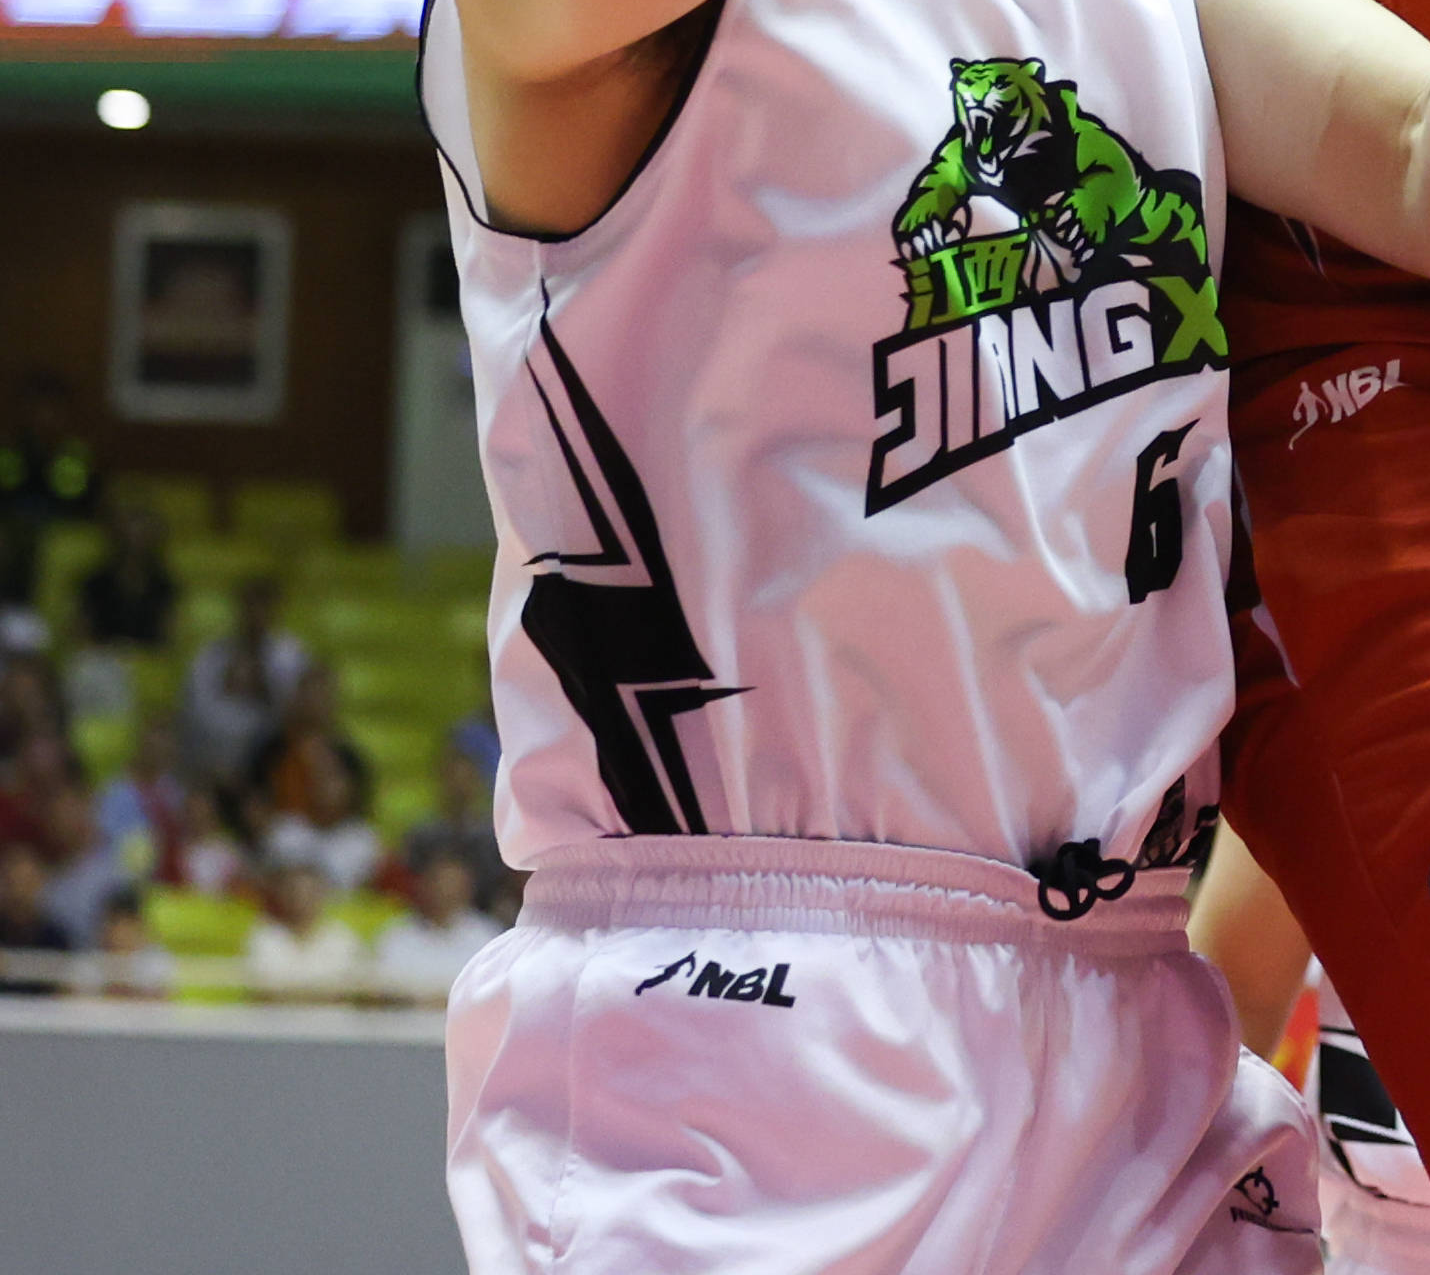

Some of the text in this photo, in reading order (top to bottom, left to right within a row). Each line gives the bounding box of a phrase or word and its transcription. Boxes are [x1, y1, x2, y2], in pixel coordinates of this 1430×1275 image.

[1320, 358, 1410, 424] NBL
[1125, 417, 1201, 605] 6
[687, 960, 798, 1009] NBL
